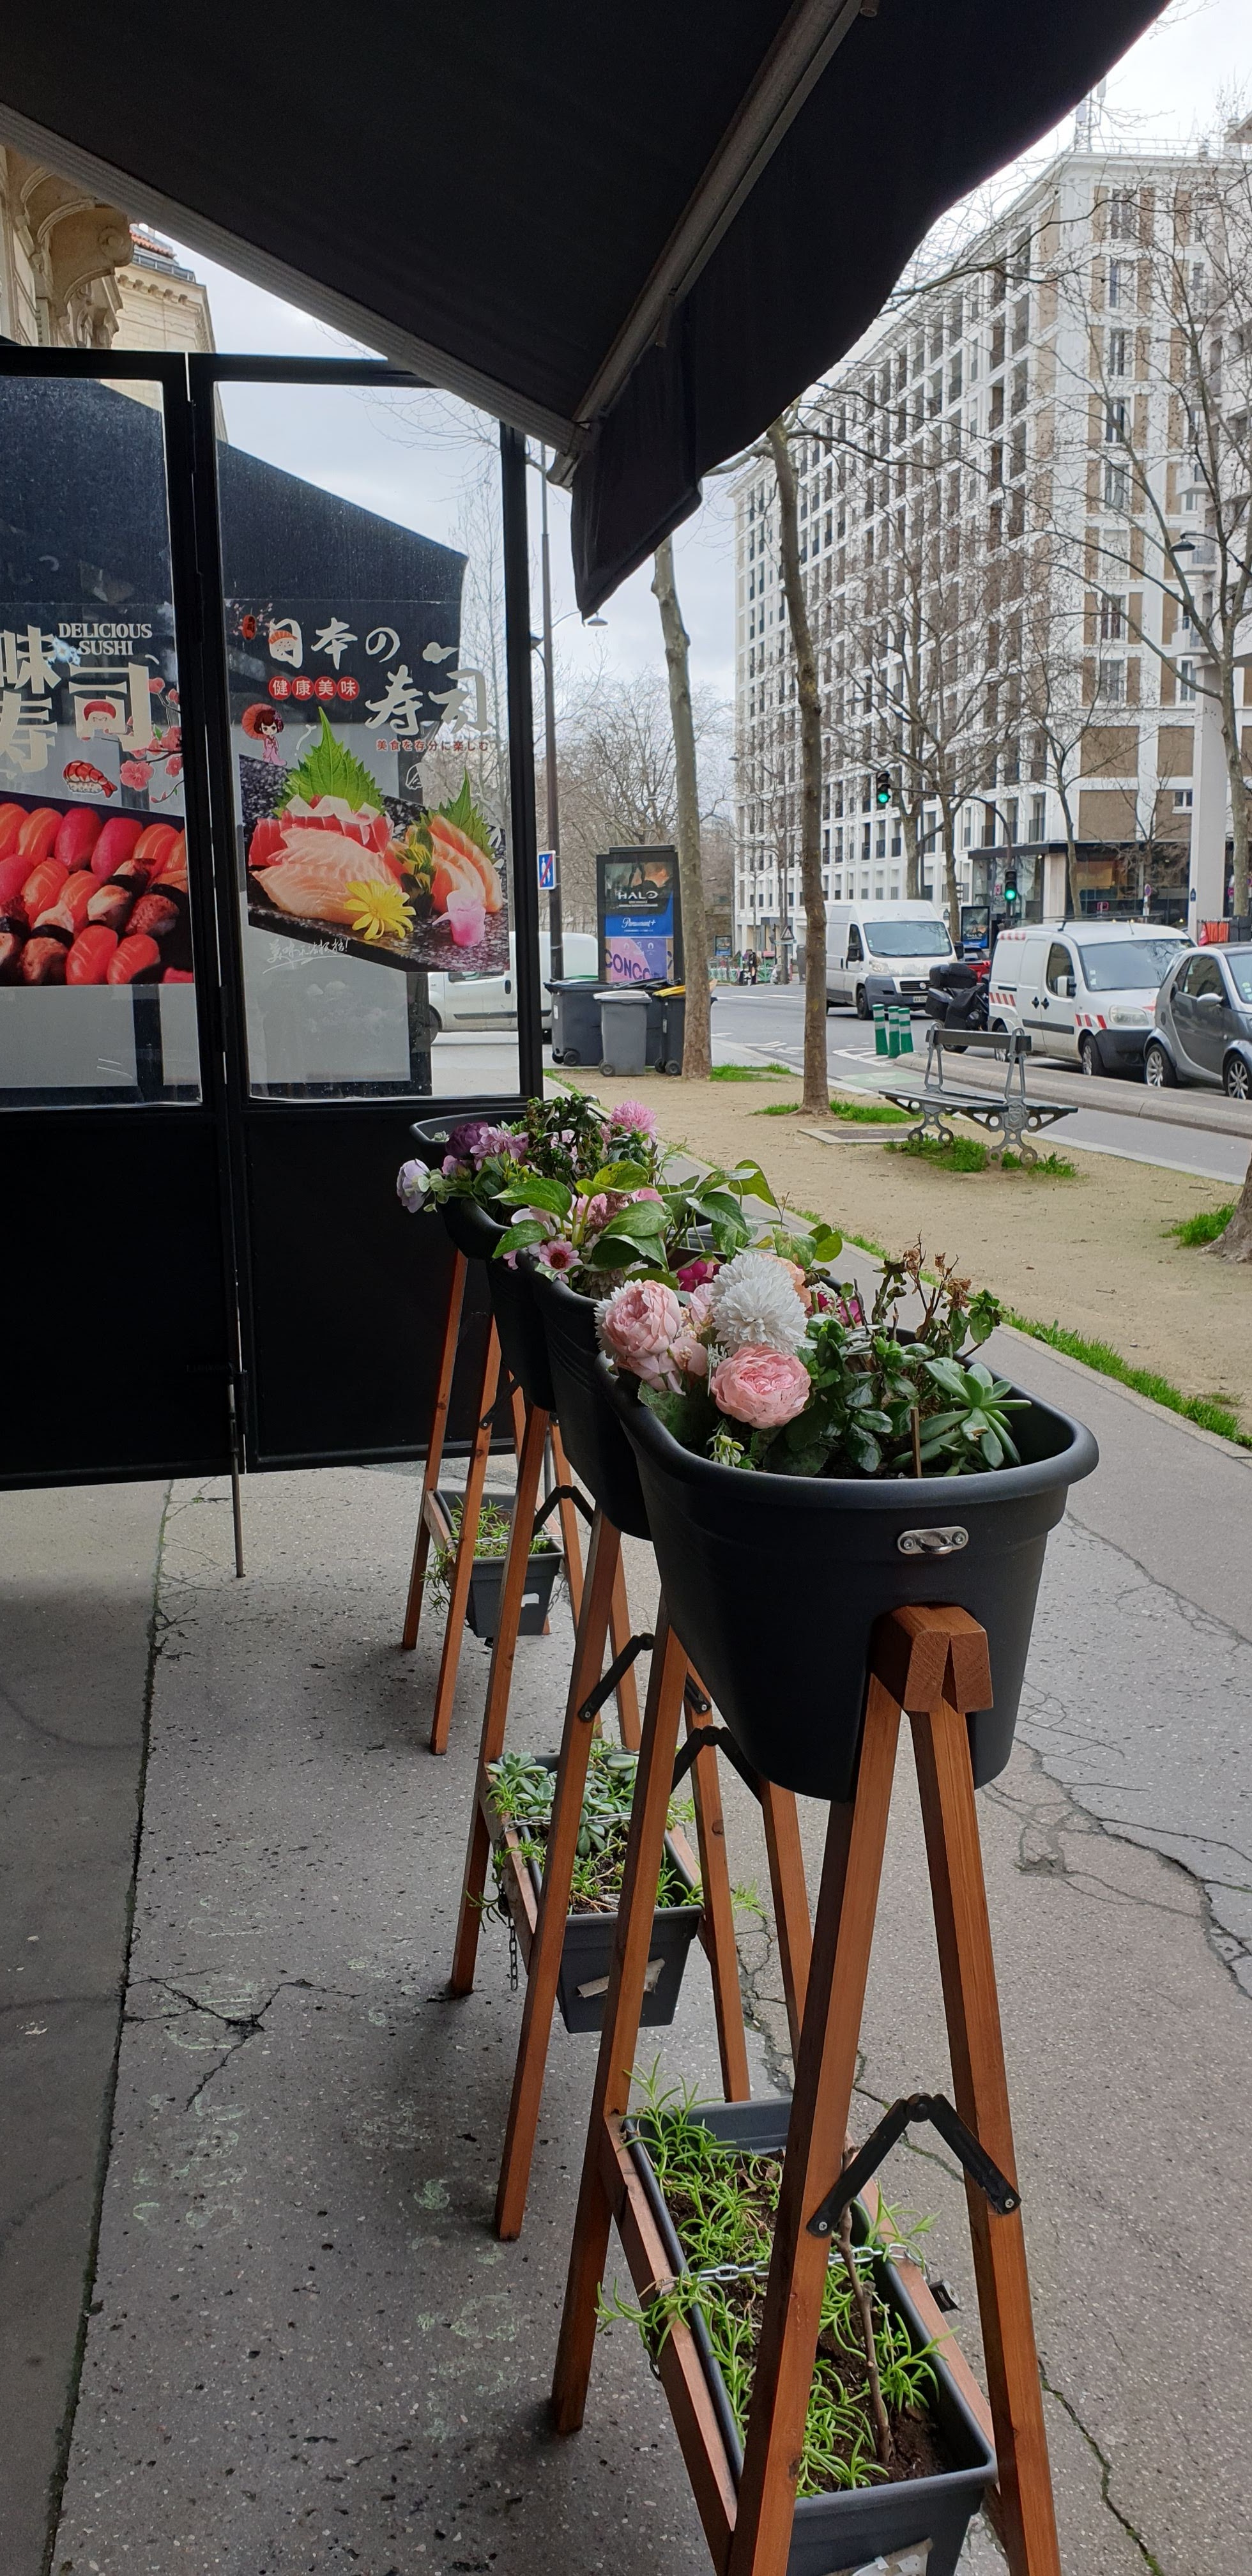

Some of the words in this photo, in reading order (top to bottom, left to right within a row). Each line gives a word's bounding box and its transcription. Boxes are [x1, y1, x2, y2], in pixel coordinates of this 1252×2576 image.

[59, 623, 152, 639] DELICIOUS
[79, 640, 134, 656] SUSHI
[268, 618, 401, 670] 日本の
[271, 678, 358, 697] 健康美味
[365, 665, 489, 735] 寿司
[376, 739, 489, 752] 美食を存分に楽しむ
[618, 891, 659, 900] HALO
